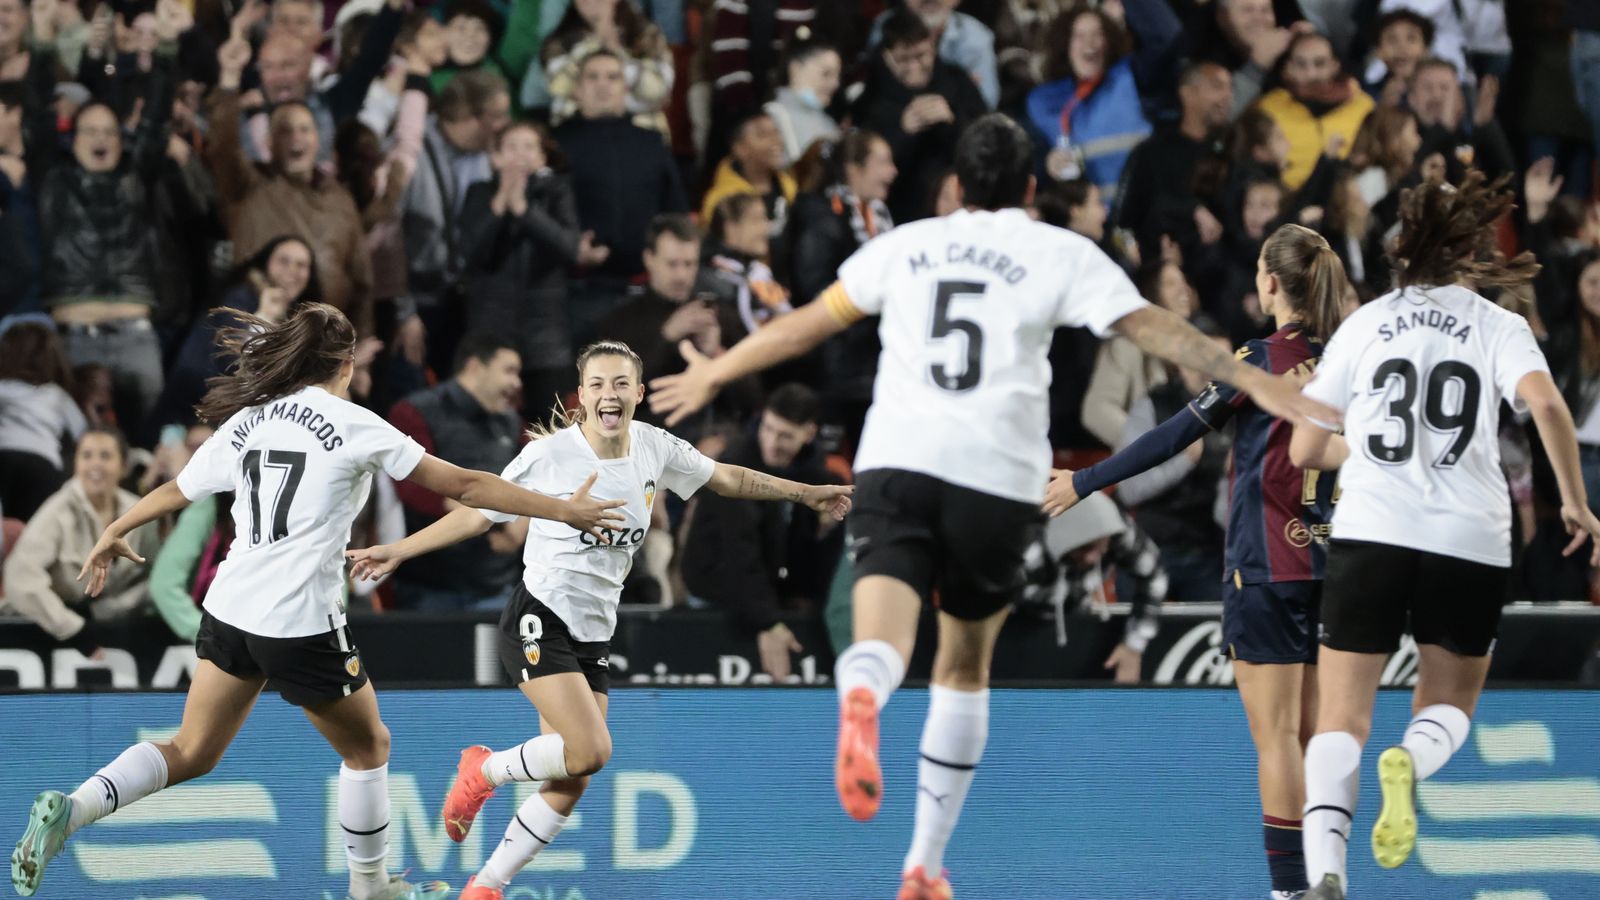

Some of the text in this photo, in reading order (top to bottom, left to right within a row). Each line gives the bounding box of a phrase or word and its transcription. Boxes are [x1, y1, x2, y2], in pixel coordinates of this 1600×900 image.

[947, 243, 1027, 285] CARRO
[926, 279, 989, 393] 5
[1378, 309, 1472, 344] SANDRA
[269, 401, 344, 452] MARCOS
[1361, 357, 1482, 471] 39
[241, 449, 307, 549] 17
